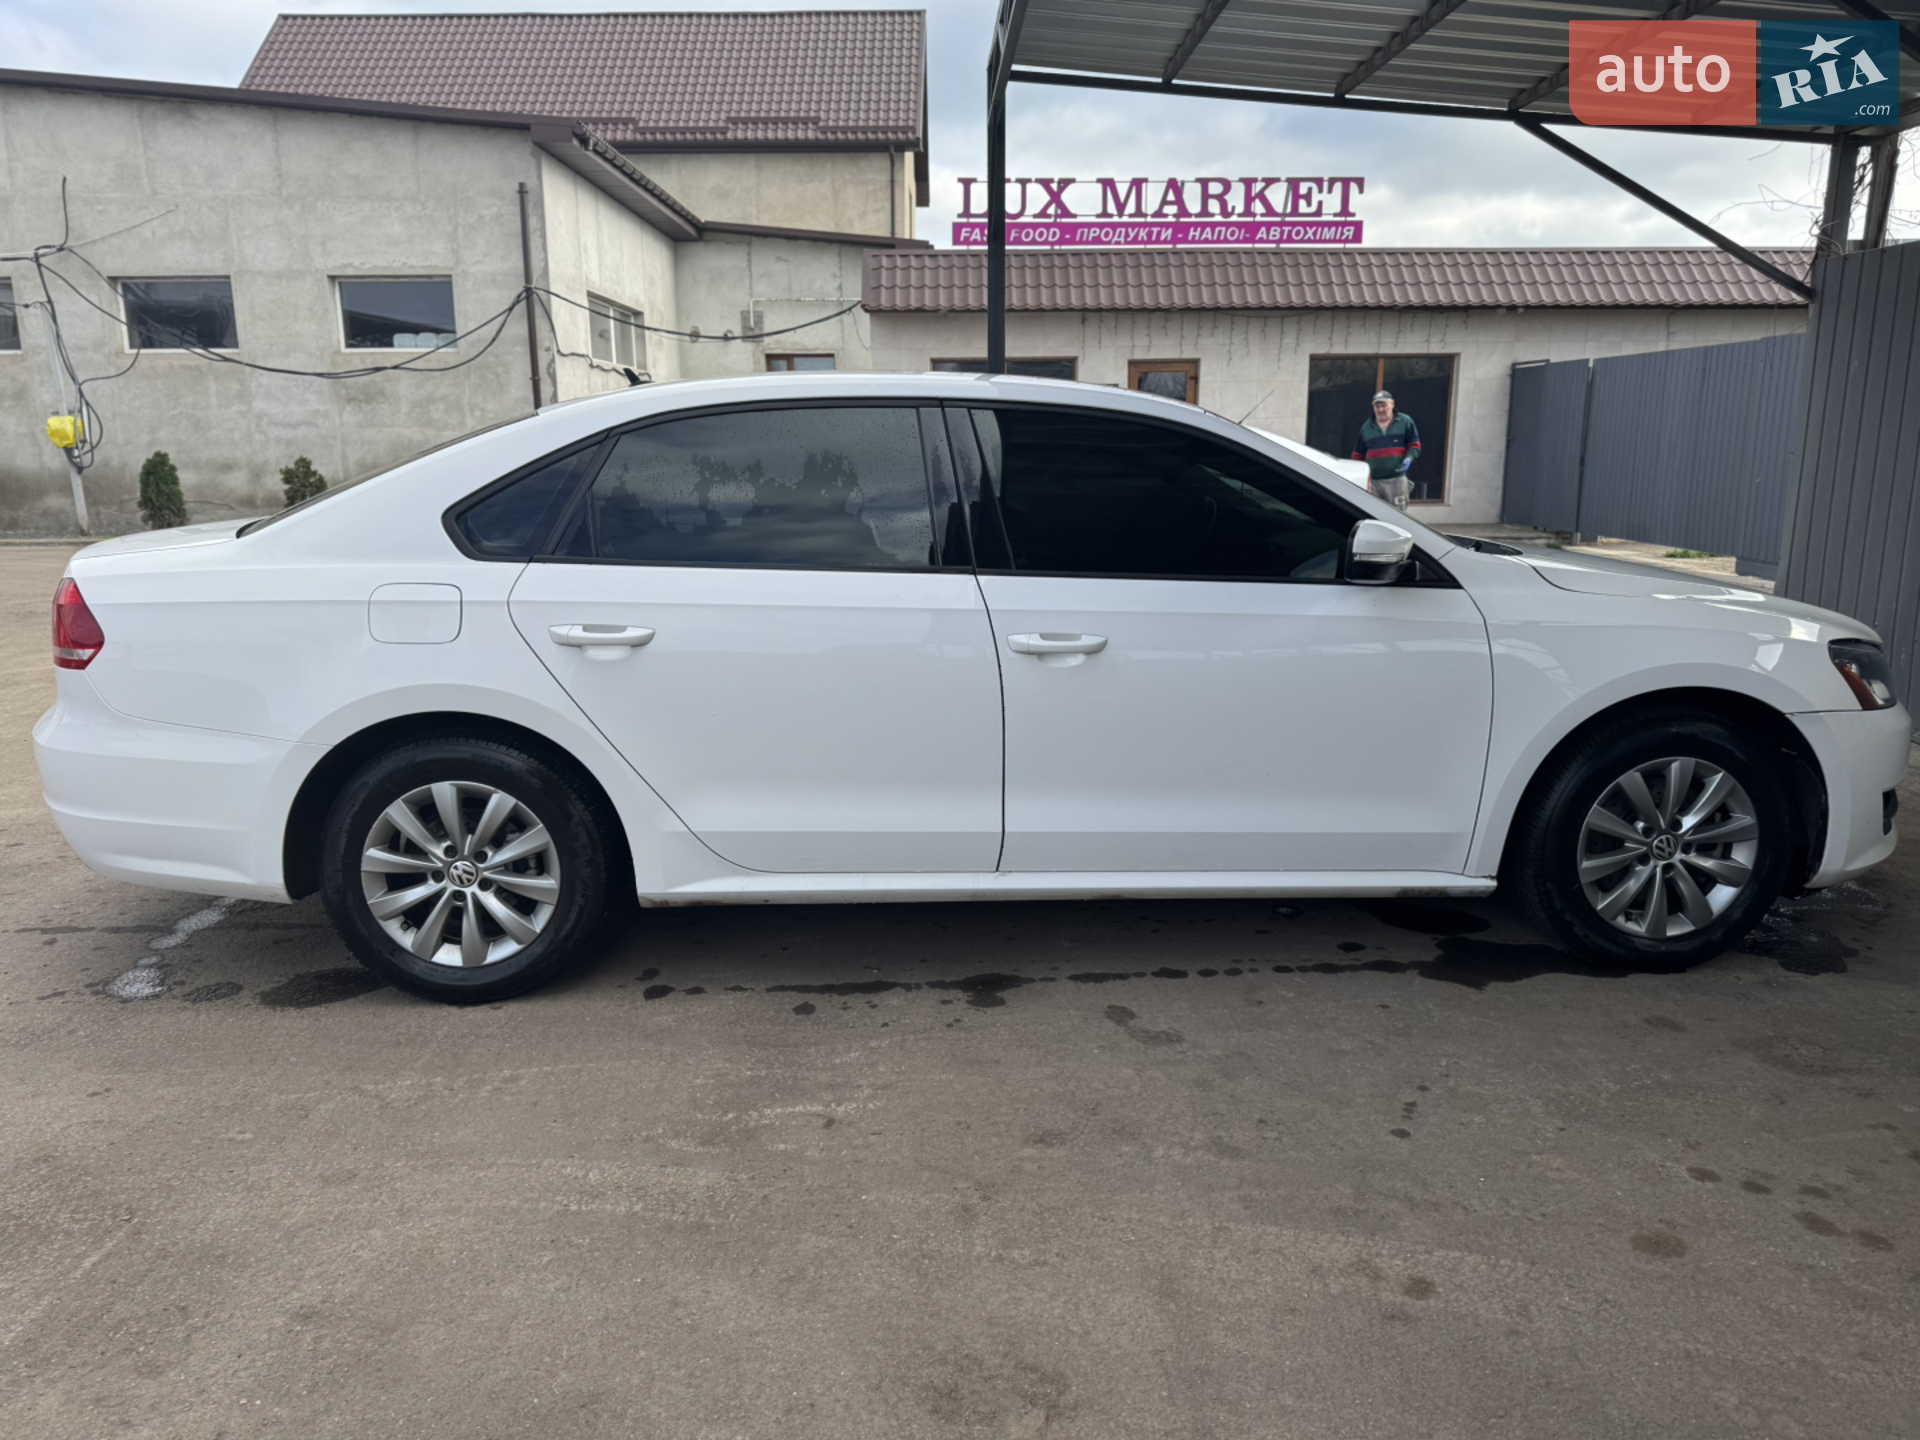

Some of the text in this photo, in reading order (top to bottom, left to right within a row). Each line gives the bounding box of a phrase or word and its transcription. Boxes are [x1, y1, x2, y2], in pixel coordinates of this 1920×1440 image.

[957, 176, 1365, 220] LUX MARKET
[1009, 227, 1061, 242] FOOD
[1075, 226, 1173, 245] ПРОДУКТИ
[1255, 225, 1355, 241] АВТОХІМІЯ
